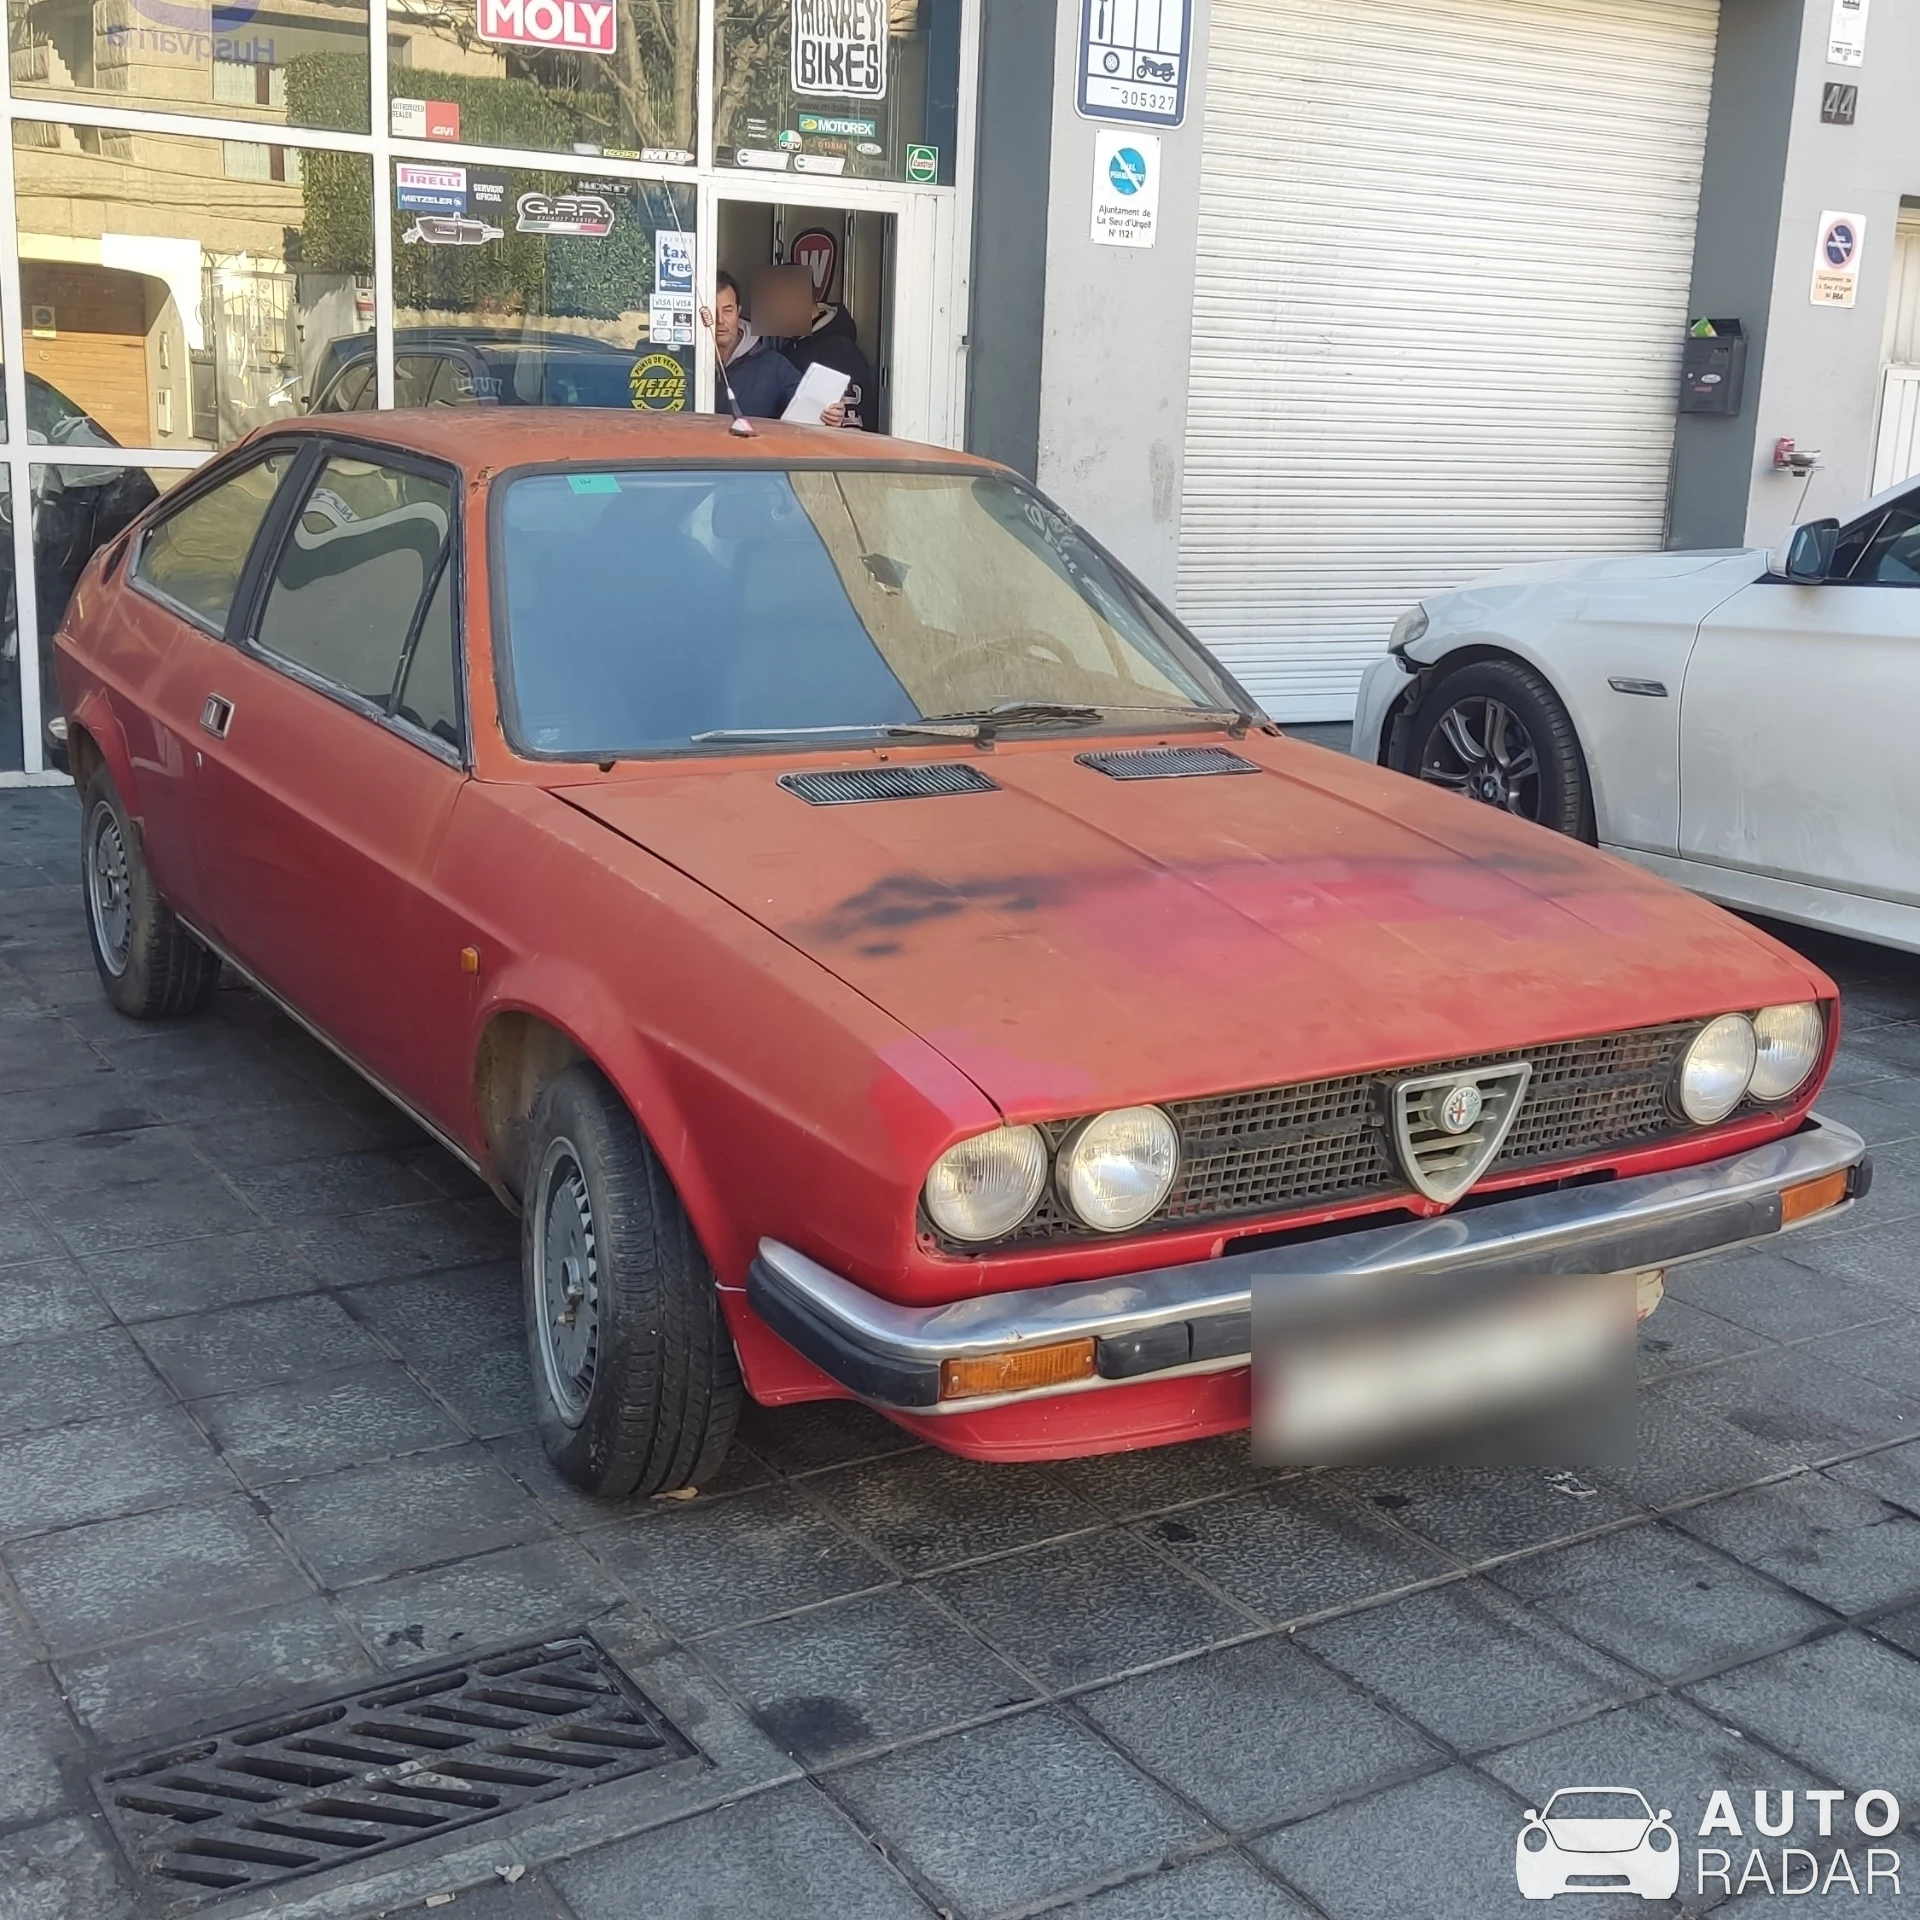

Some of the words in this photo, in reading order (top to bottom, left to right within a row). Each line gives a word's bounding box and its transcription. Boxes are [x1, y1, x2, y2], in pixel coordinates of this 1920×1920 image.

[486, 0, 612, 45] MOLY
[800, 0, 878, 41] MONKEY
[801, 39, 879, 89] BIKES
[1823, 85, 1856, 121] 44
[432, 126, 454, 136] GIVI
[817, 119, 873, 135] MOTOREX
[401, 168, 461, 187] PIRELLI
[473, 183, 504, 194] SERVICIO
[401, 194, 453, 206] METZELER
[475, 192, 502, 202] OFICIAL
[525, 201, 609, 218] G.P.R.
[1099, 205, 1140, 216] Ajuntament
[1142, 209, 1151, 217] de
[1097, 216, 1106, 224] La
[1109, 217, 1123, 226] Seu
[1119, 229, 1133, 238] 1121
[662, 244, 687, 258] tax
[664, 259, 692, 278] free
[635, 358, 653, 375] PUNTO
[653, 356, 661, 364] DE
[663, 358, 679, 375] VENTA
[629, 378, 687, 389] METAL
[635, 388, 685, 398] LUBE
